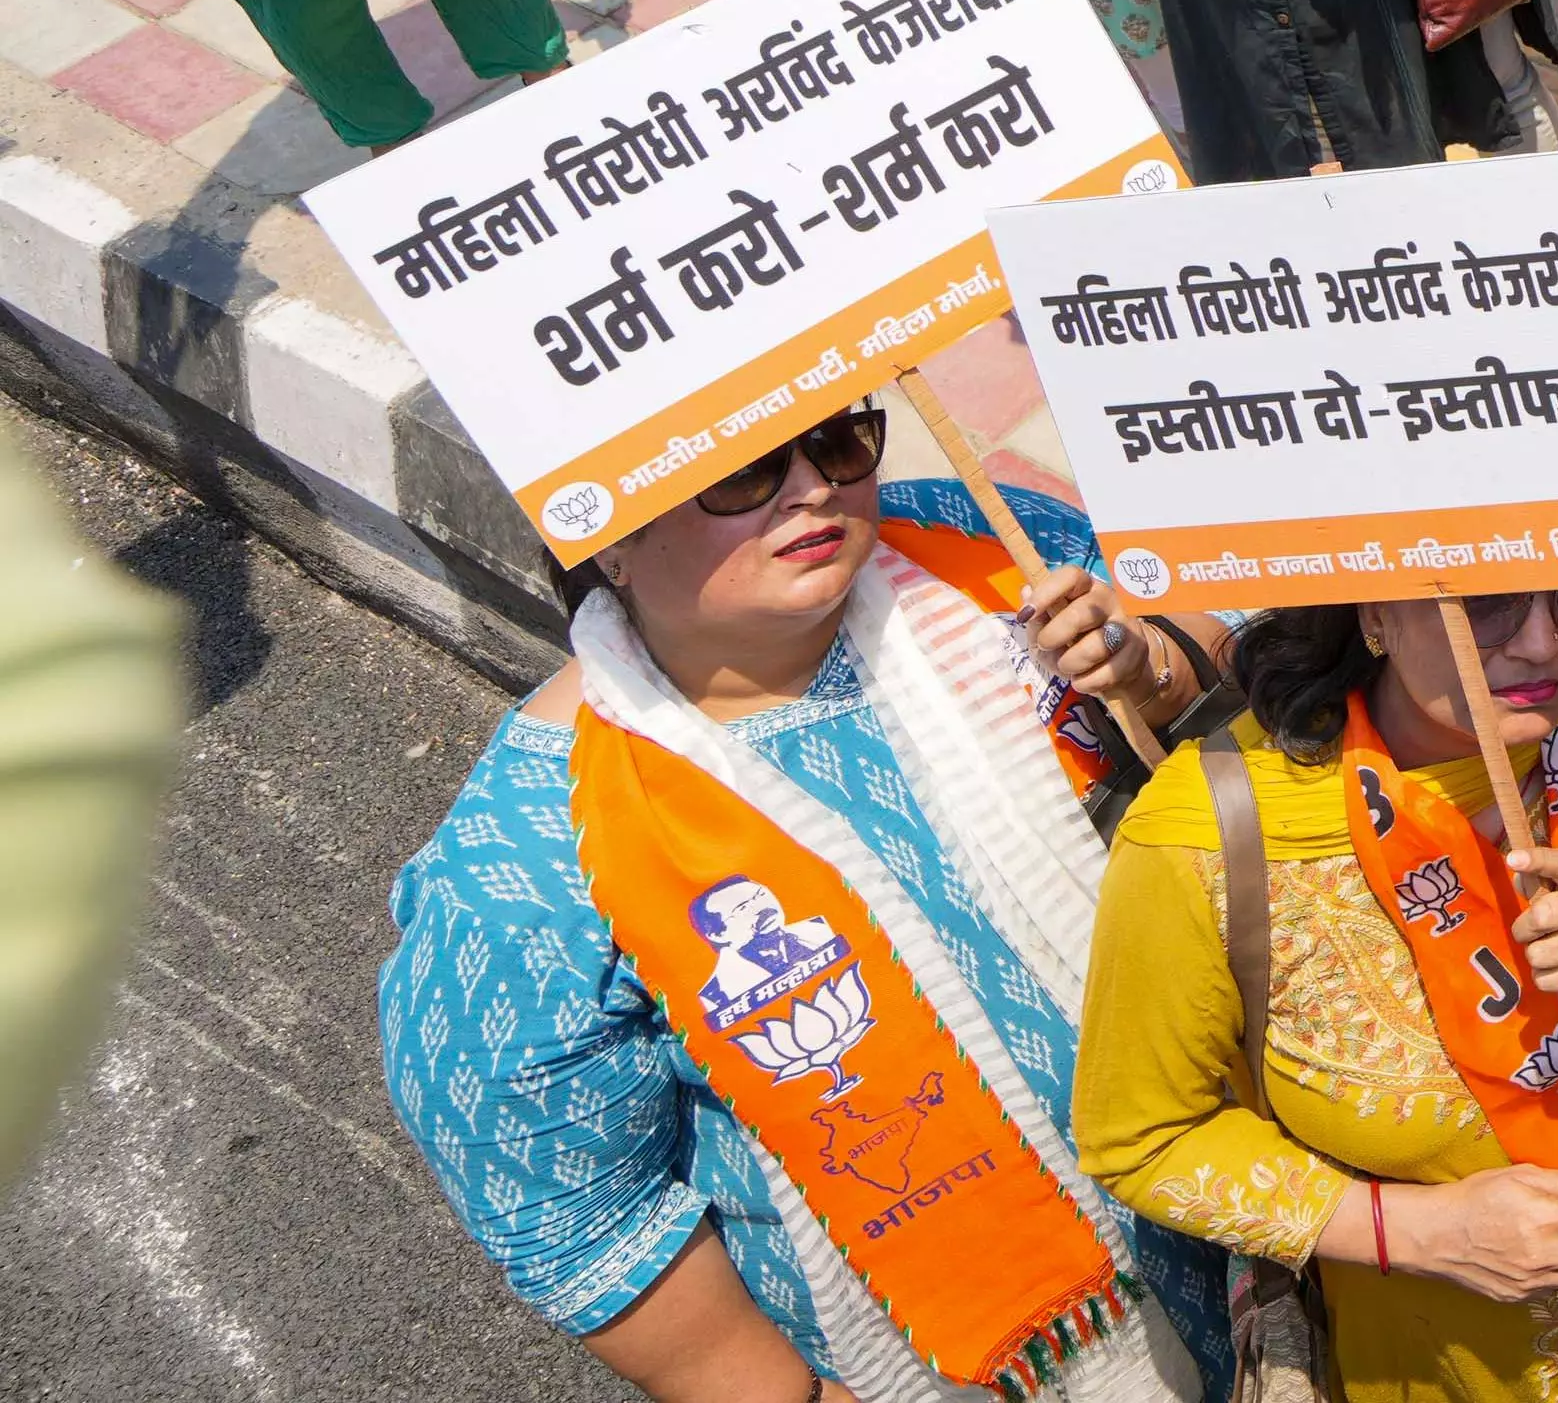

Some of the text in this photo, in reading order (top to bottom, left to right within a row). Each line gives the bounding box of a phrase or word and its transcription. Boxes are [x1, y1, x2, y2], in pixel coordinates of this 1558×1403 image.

[373, 178, 558, 298] महिला
[544, 91, 709, 220] विरोधी
[702, 19, 855, 141] अरविंद
[534, 246, 675, 386] शर्म
[924, 55, 1055, 169] करो
[1040, 274, 1178, 346] महिला
[1176, 257, 1310, 337] विरोधी
[1315, 241, 1451, 323] अरविंद
[1104, 380, 1303, 463] इस्तीफा
[1178, 551, 1261, 582] भारतीय
[1263, 553, 1335, 576] जनता
[1398, 537, 1476, 569] महिला
[863, 1149, 996, 1239] भाजपा
